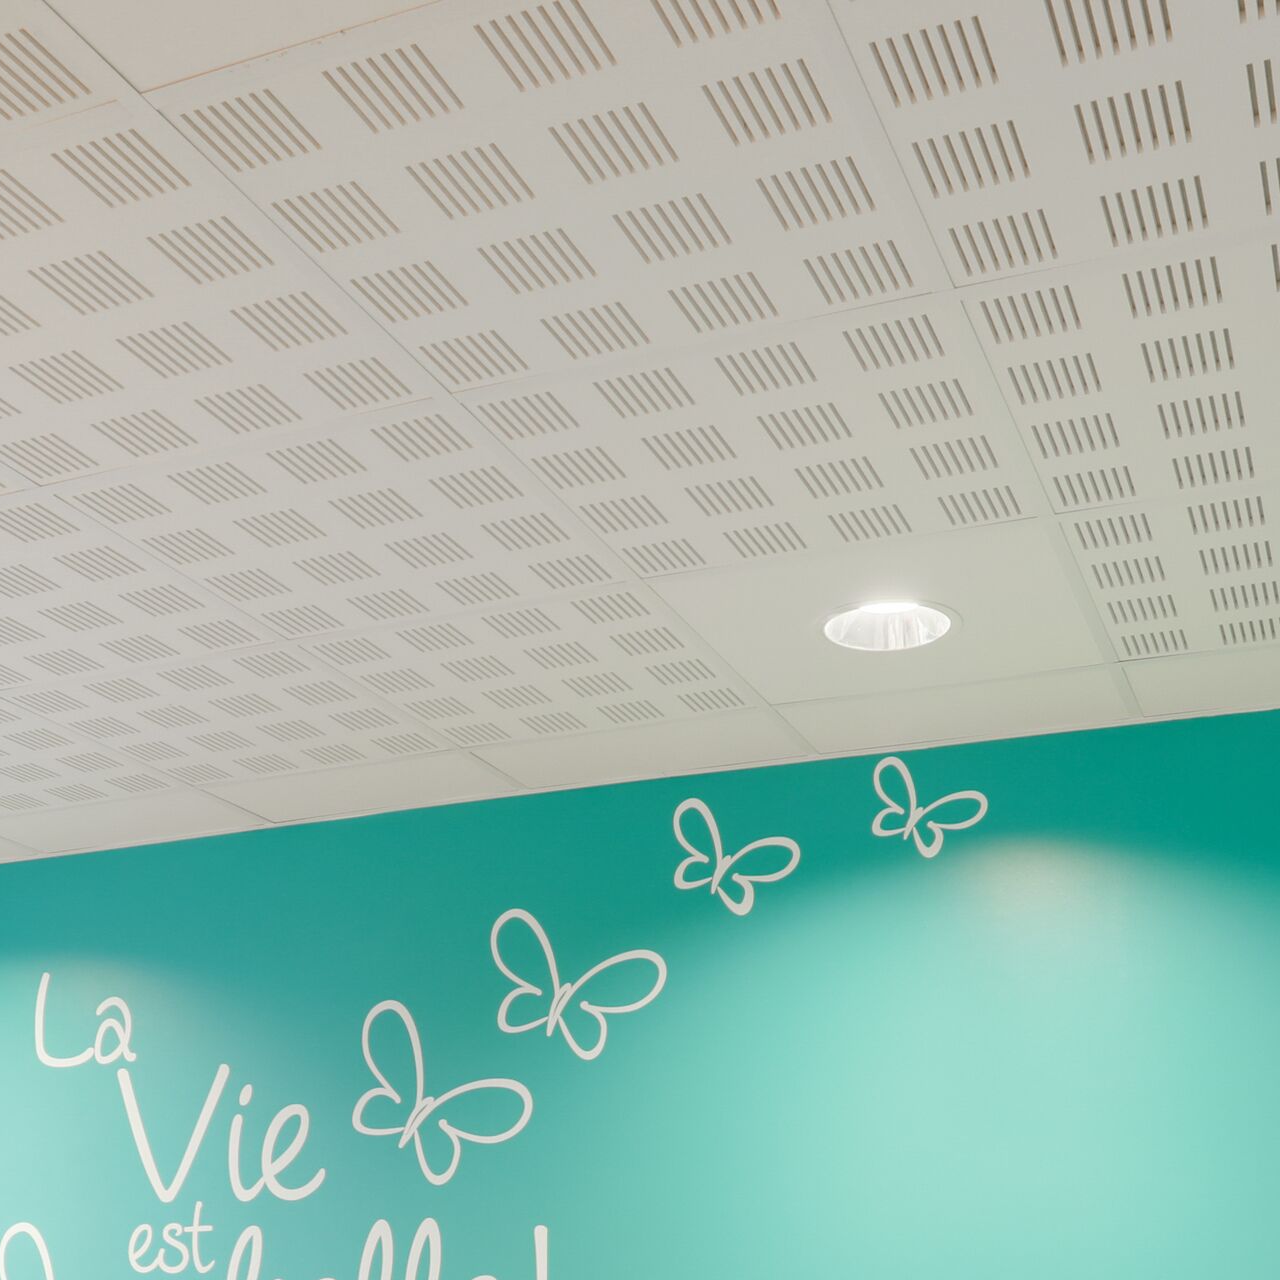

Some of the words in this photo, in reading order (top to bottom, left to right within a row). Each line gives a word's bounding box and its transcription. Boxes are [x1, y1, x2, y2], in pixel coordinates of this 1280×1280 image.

[33, 971, 138, 1069] La
[117, 1063, 326, 1204] Vie
[128, 1200, 215, 1274] est
